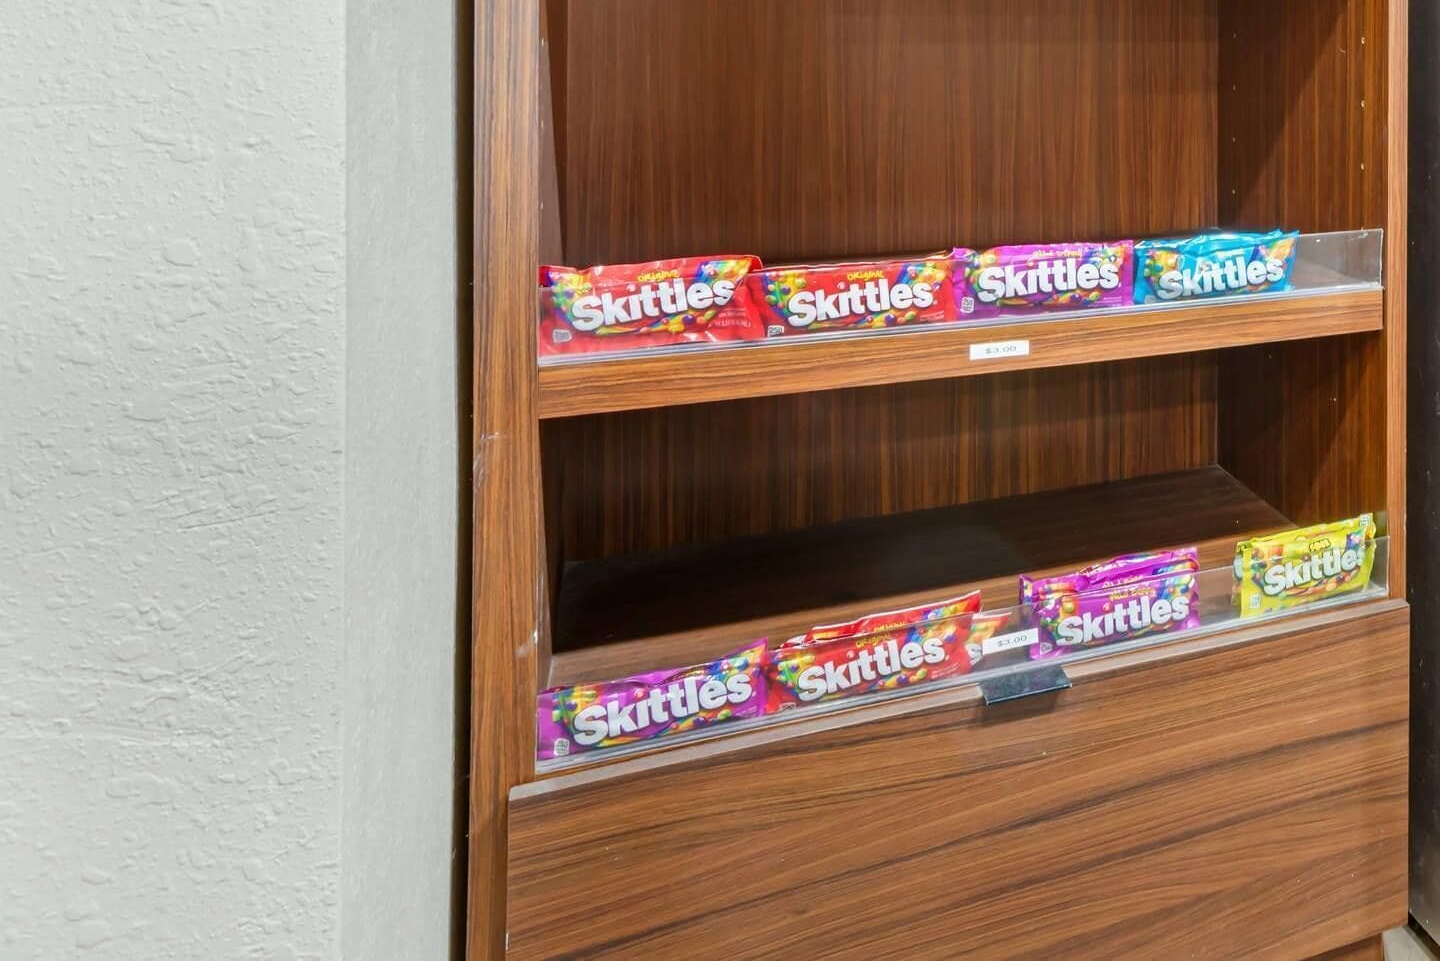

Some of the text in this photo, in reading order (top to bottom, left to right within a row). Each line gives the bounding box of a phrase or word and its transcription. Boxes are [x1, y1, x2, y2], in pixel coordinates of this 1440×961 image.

[847, 270, 885, 282] ORIGINAL
[977, 257, 1120, 303] Skittles
[1157, 254, 1284, 300] Skittles
[572, 277, 735, 332] Skittles
[788, 278, 934, 328] Skittles
[1056, 595, 1190, 647] Skittles
[798, 637, 947, 702] Skittles
[573, 673, 754, 746] Skittles
